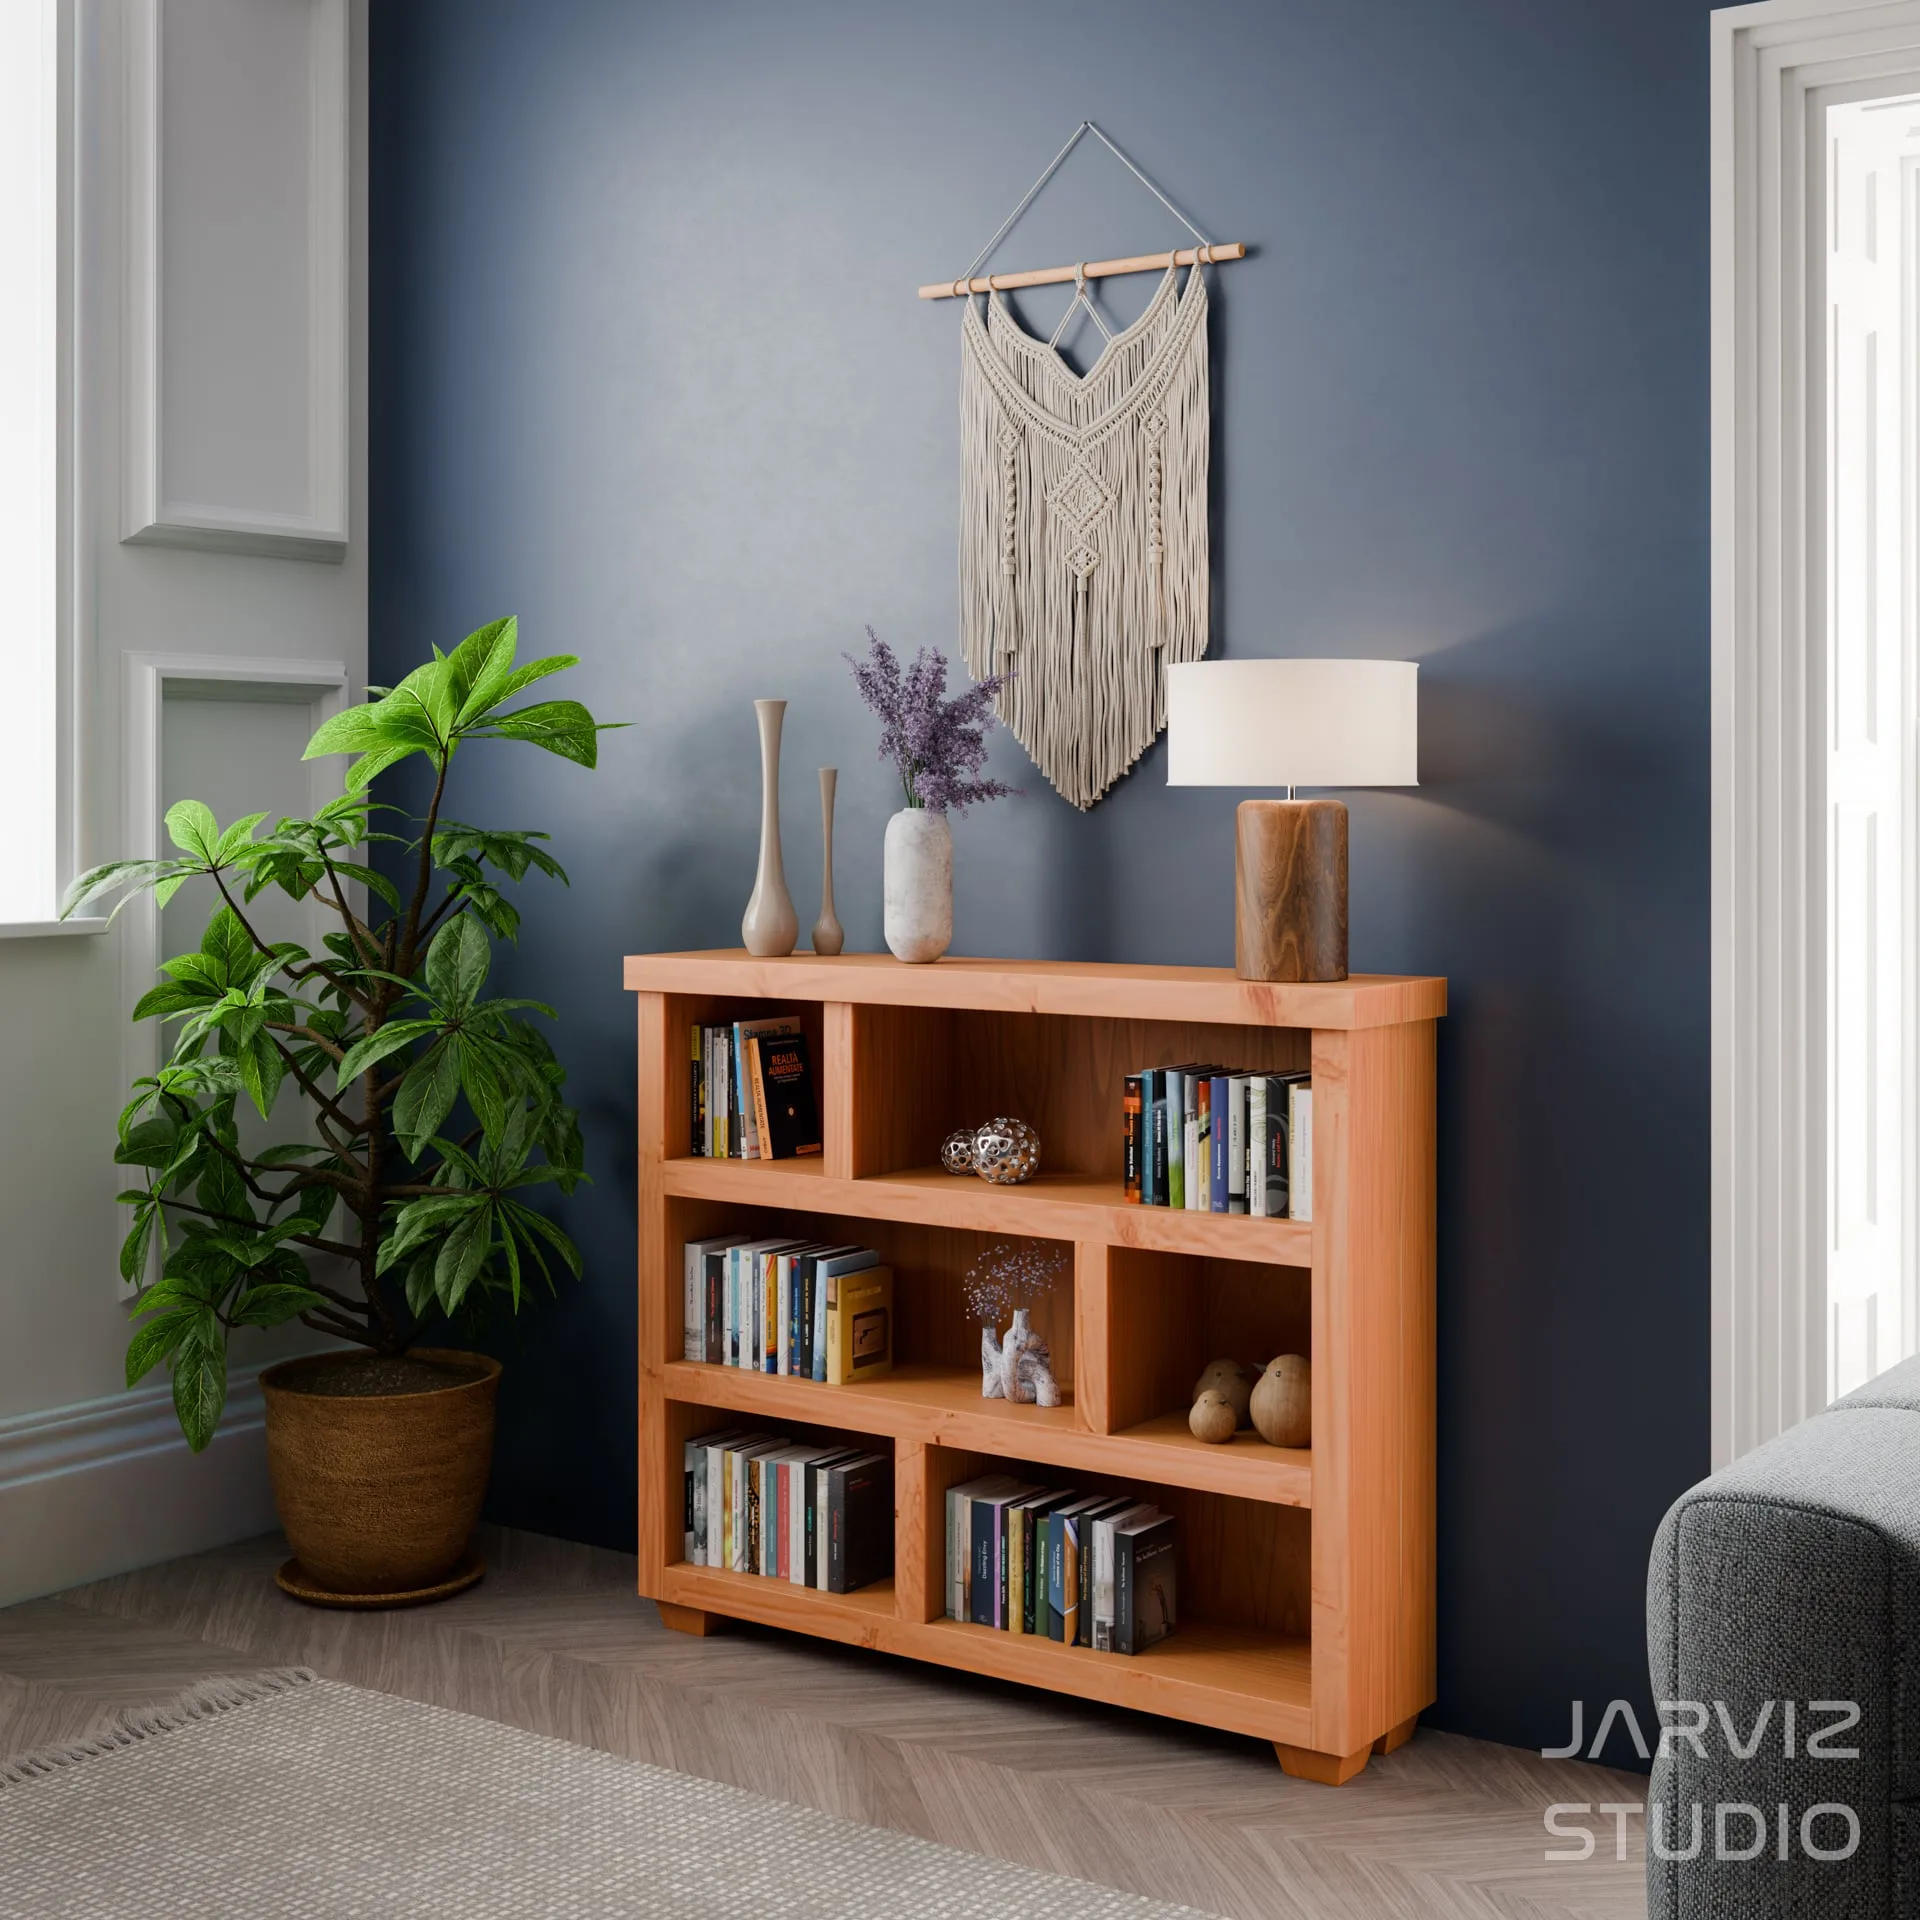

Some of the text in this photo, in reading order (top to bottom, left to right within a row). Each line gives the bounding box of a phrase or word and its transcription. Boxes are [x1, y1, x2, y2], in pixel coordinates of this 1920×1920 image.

[771, 1051, 798, 1065] REALTÀ
[768, 1063, 804, 1076] AUMENTATE
[981, 1555, 989, 1580] Dazzling
